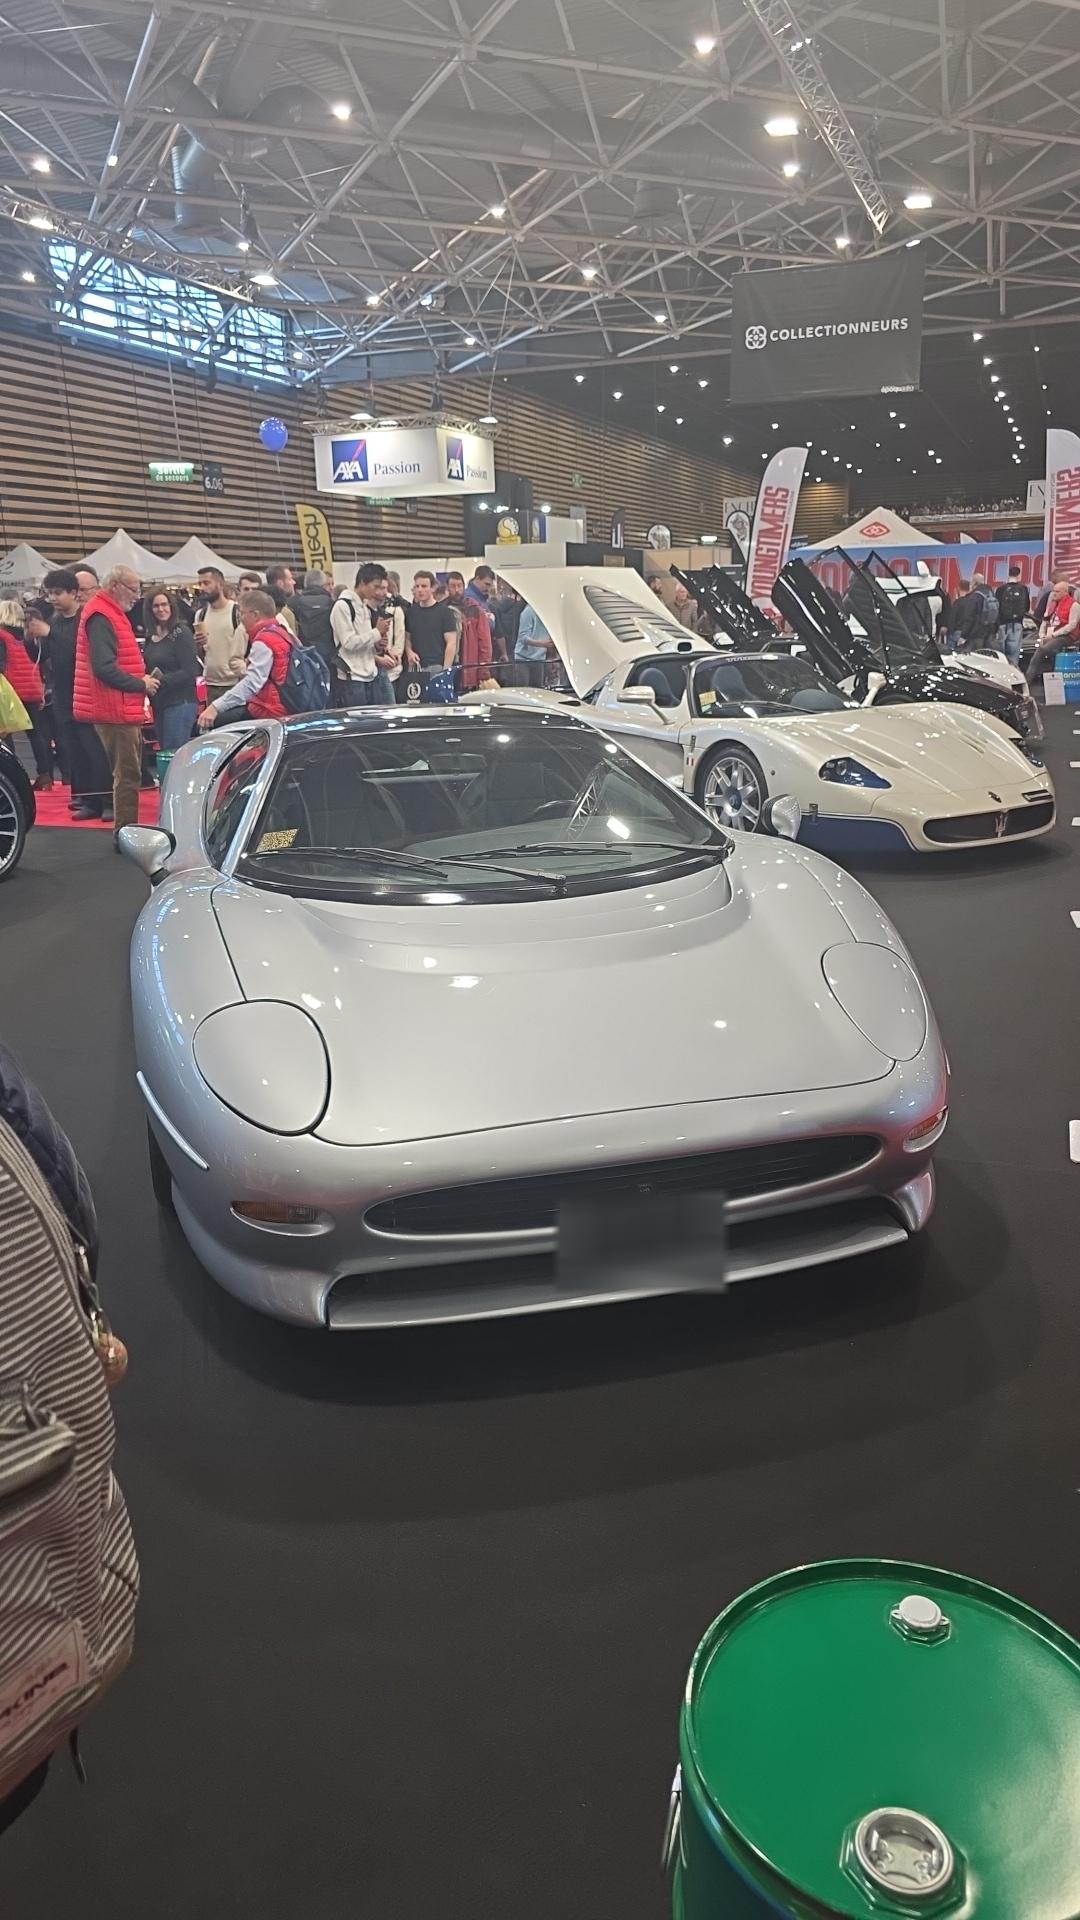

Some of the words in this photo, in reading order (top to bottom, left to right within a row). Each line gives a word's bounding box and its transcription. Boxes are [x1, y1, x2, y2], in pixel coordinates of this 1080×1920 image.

[770, 317, 909, 341] COLLECTIONNEURS
[333, 460, 364, 481] AXA
[373, 460, 421, 476] Passion
[447, 458, 463, 478] AXA
[466, 464, 488, 481] Passion
[204, 476, 223, 491] 6.06
[751, 485, 790, 600] YOUNGTIMERS
